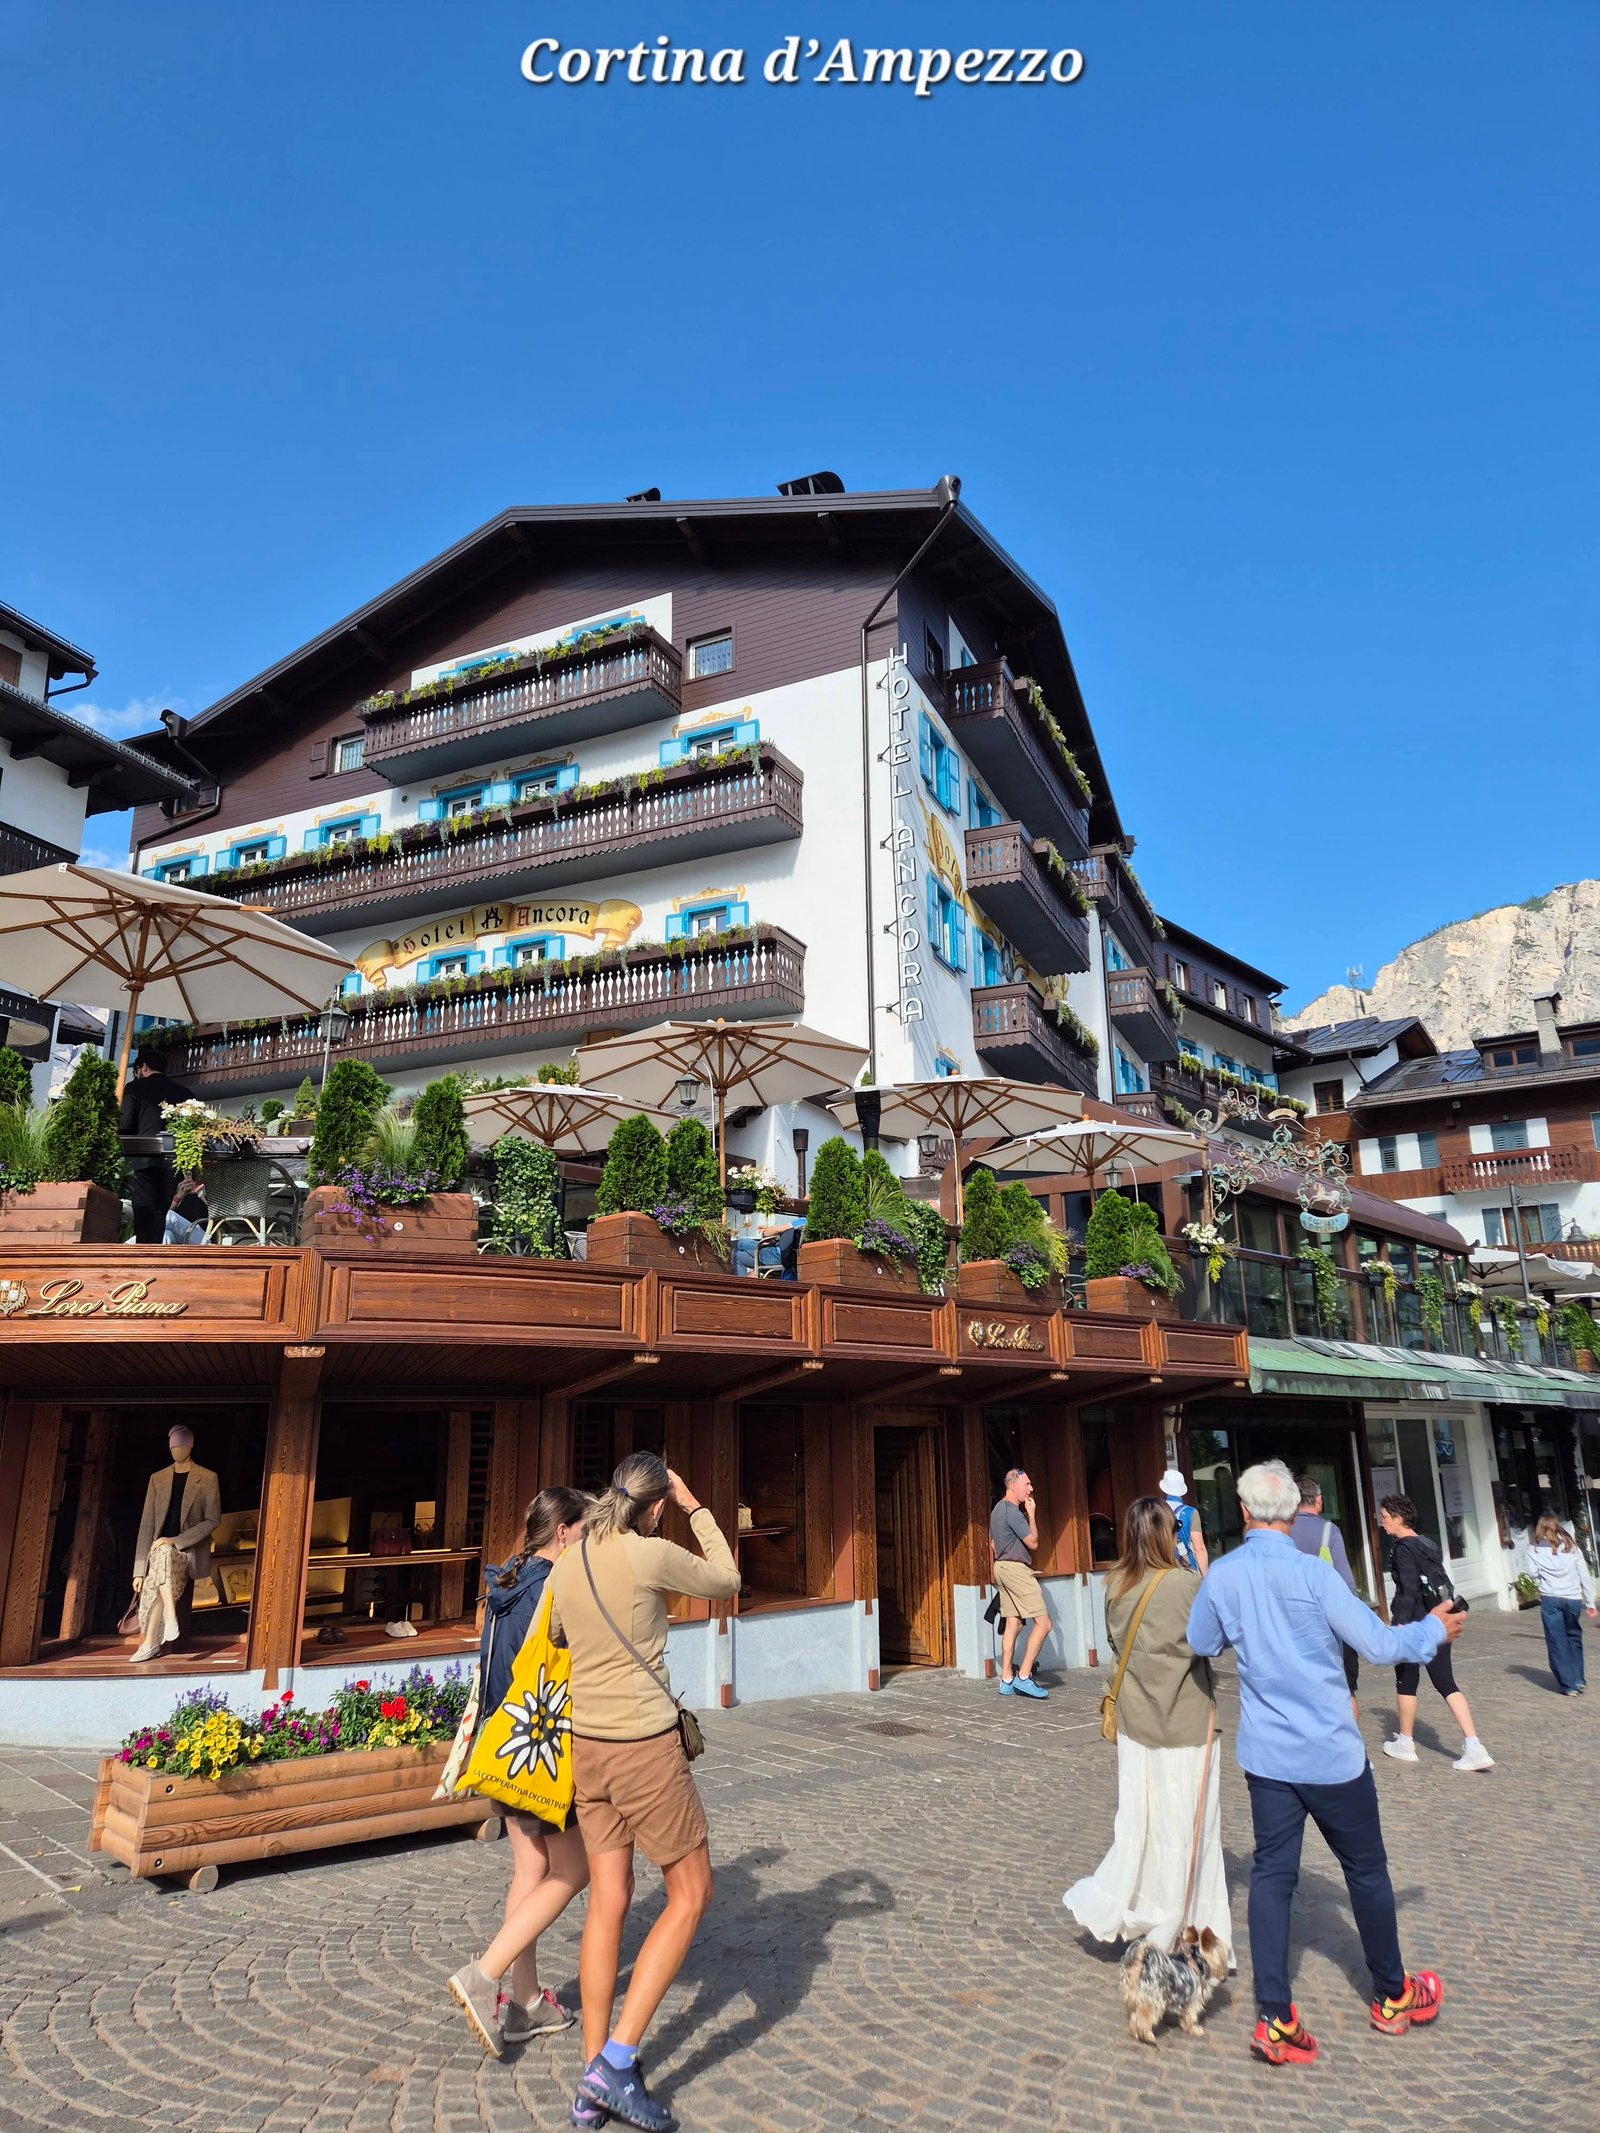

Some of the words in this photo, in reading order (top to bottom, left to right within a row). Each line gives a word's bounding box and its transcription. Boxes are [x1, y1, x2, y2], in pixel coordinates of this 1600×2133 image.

[890, 642, 912, 800] HOTEL
[402, 919, 465, 955] Hotel
[516, 905, 590, 928] Ancora
[894, 824, 924, 1024] ANCORA
[25, 1279, 102, 1315] Loro
[102, 1277, 189, 1315] Piana
[473, 1767, 481, 1777] LA
[481, 1773, 528, 1796] COOPERATIVA
[528, 1791, 537, 1801] DI
[536, 1795, 566, 1811] CORTINA
